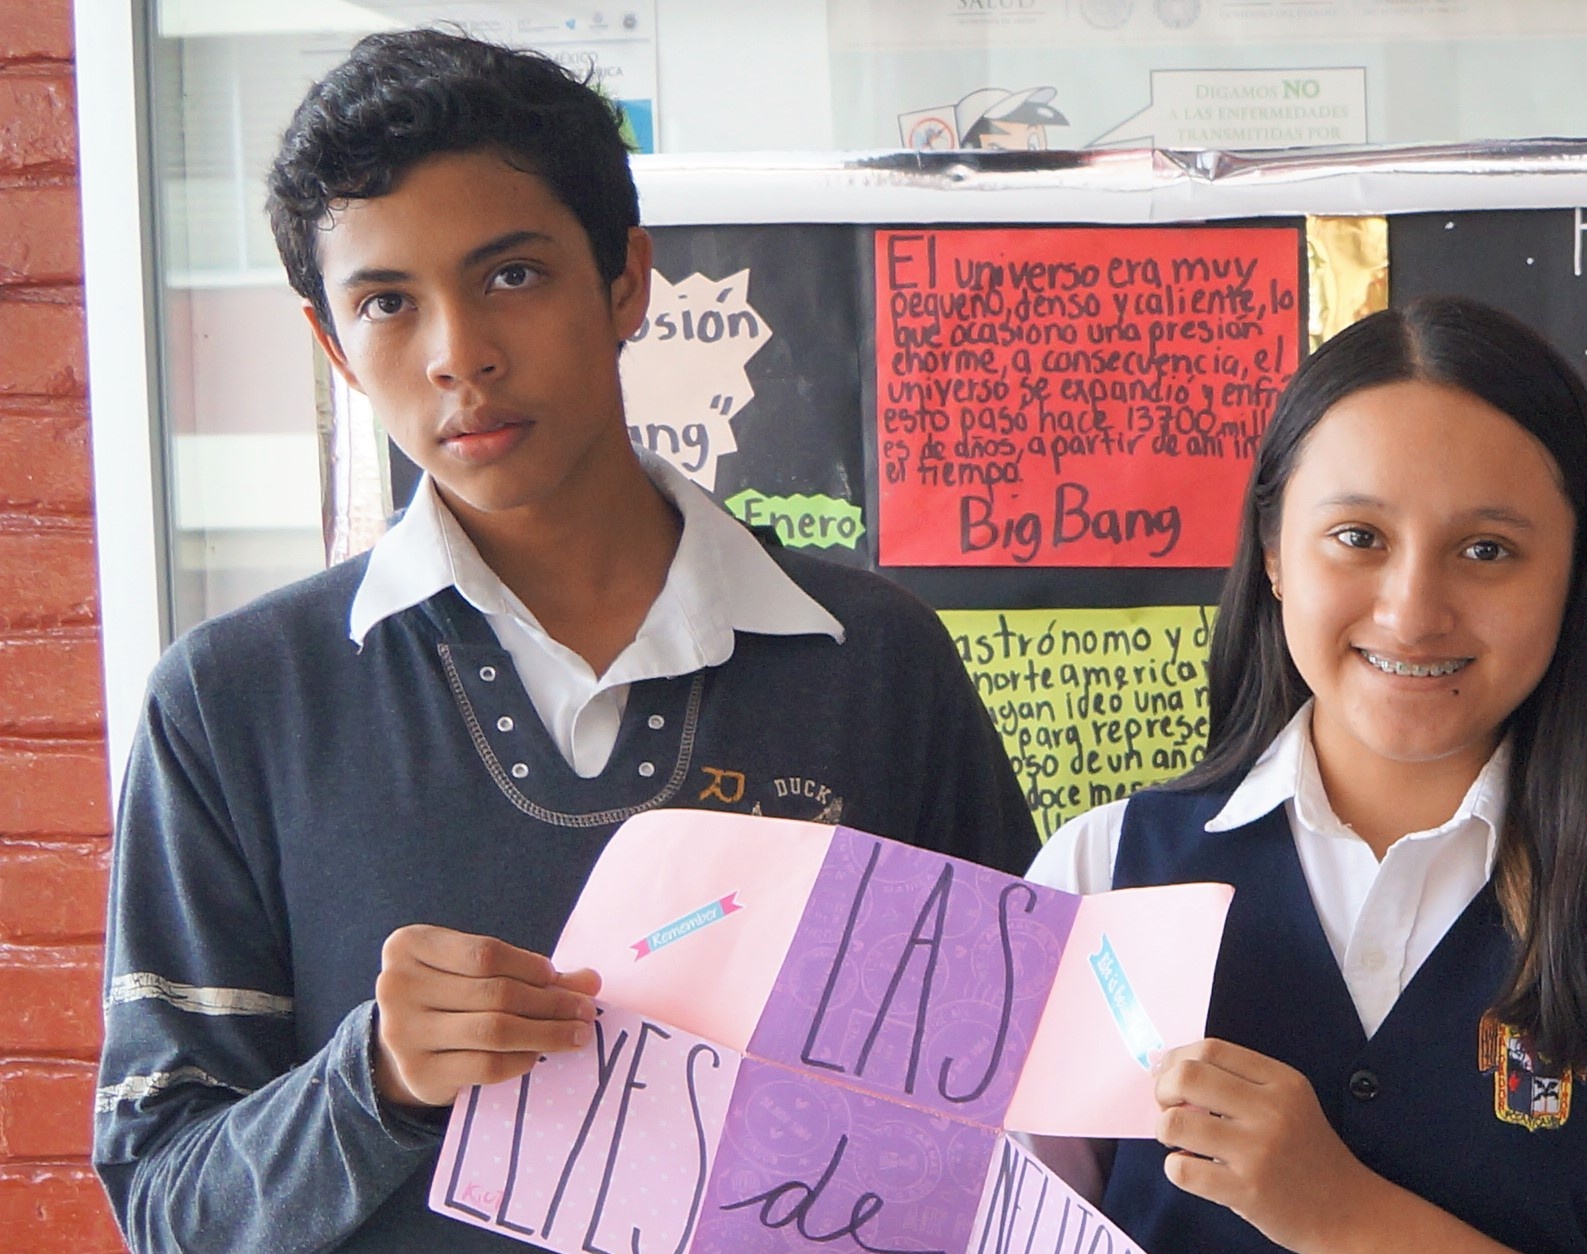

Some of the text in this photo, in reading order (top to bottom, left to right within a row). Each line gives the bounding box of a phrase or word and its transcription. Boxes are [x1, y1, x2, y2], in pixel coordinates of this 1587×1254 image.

[1282, 79, 1320, 99] NO
[1184, 105, 1349, 120] LAS ENFERMEDADES
[1307, 126, 1341, 140] POR
[888, 234, 1258, 293] El universo era muy
[1270, 278, 1294, 315] lo
[1011, 349, 1031, 374] a
[1253, 335, 1284, 373] el
[884, 406, 950, 434] esto
[744, 498, 857, 539] Enero
[960, 482, 1181, 564] Big Bang
[1135, 690, 1184, 714] una
[773, 777, 832, 805] DUCK
[651, 905, 719, 948] Remember
[801, 841, 1038, 1104] LAS
